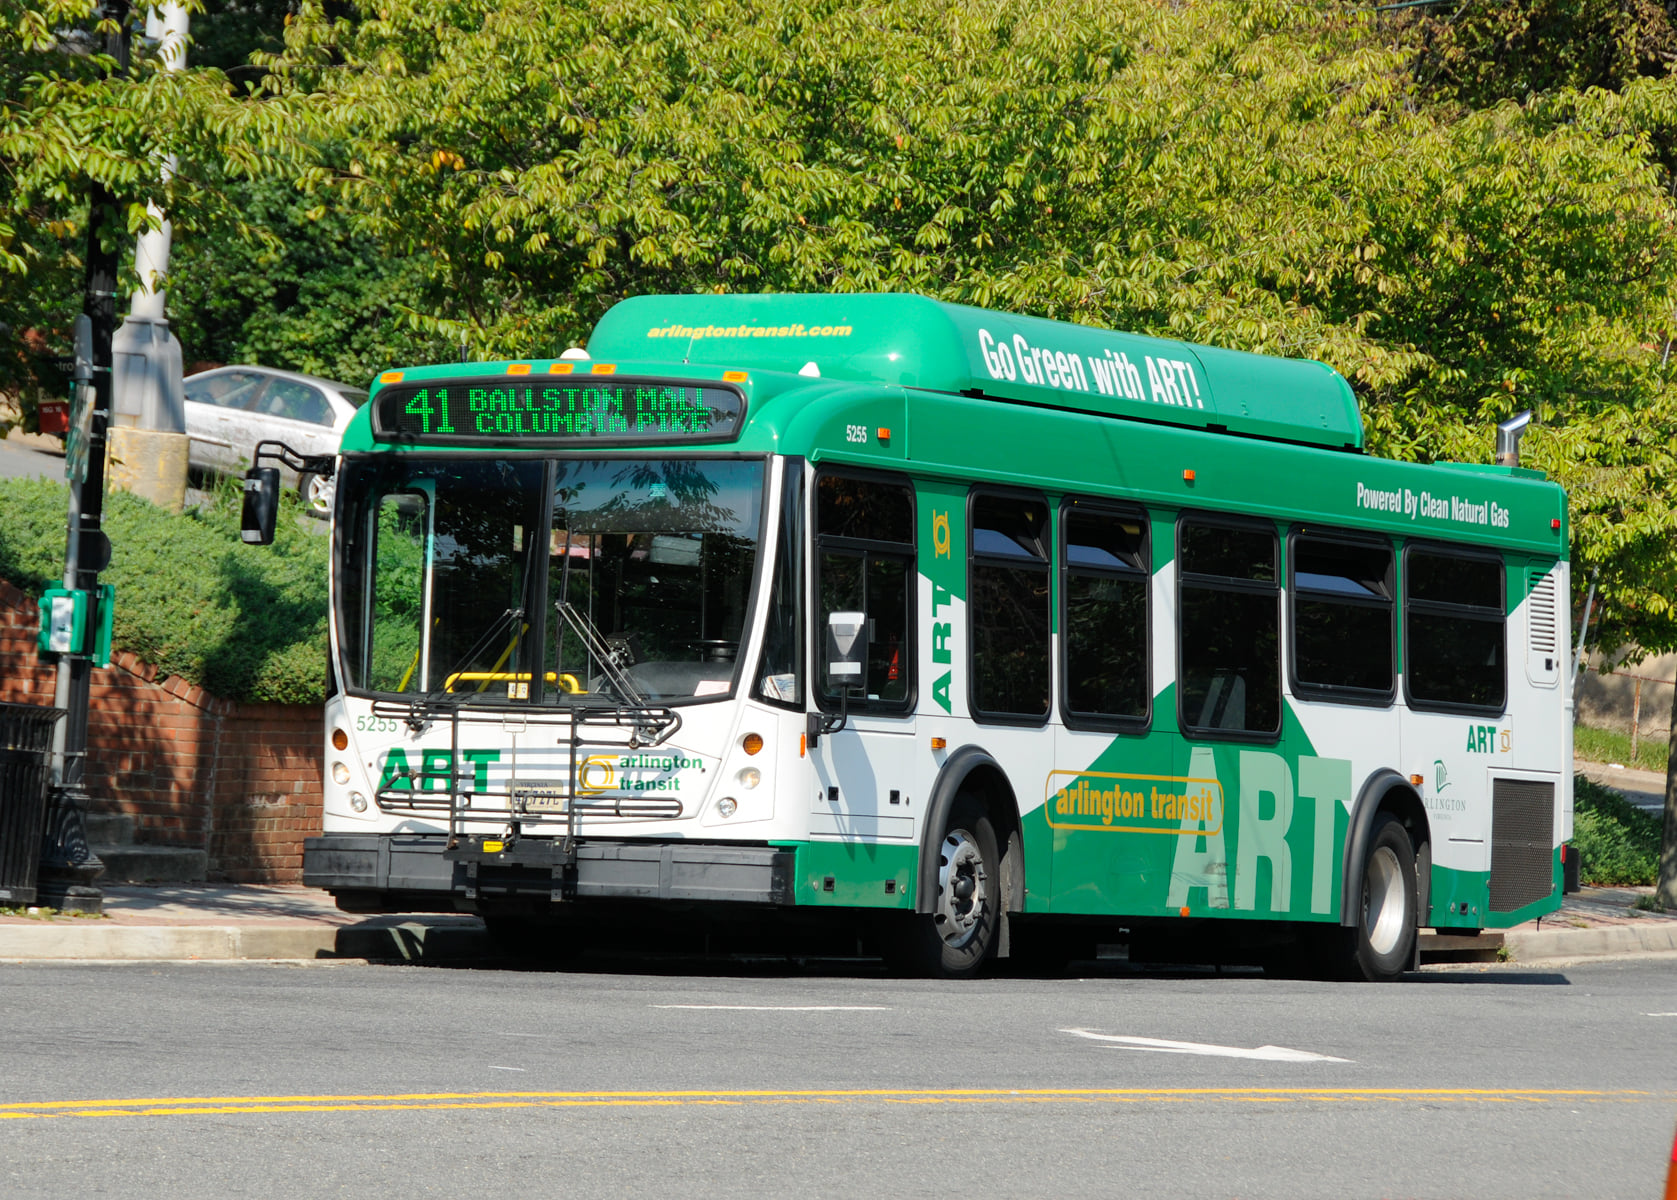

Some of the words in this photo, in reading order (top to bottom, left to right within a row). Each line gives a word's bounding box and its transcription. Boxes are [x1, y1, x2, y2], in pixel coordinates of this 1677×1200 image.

[647, 324, 852, 340] arlingtontransit.com
[978, 328, 1016, 382] Go
[1013, 333, 1089, 391] Green
[1088, 349, 1146, 401] with
[1144, 355, 1204, 409] ART!
[404, 388, 455, 433] 41
[469, 388, 624, 411] BALLSTON
[636, 387, 712, 411] MALL
[475, 412, 627, 433] COLUMBIA
[637, 412, 709, 433] PIKE
[846, 424, 867, 443] 5255
[1357, 482, 1401, 512] Powered
[1404, 489, 1418, 520] By
[1420, 491, 1448, 519] Clean
[1451, 496, 1488, 525] Natural
[1491, 502, 1509, 528] Gas
[932, 579, 951, 715] ART
[356, 715, 398, 732] 5255
[1466, 725, 1497, 754] ART
[377, 747, 500, 794] ART
[620, 754, 703, 772] arlington
[620, 776, 680, 791] transit
[1056, 780, 1144, 826] arlington
[1151, 786, 1213, 822] transit
[1424, 797, 1466, 812] RLINGTON
[1165, 746, 1353, 915] ART
